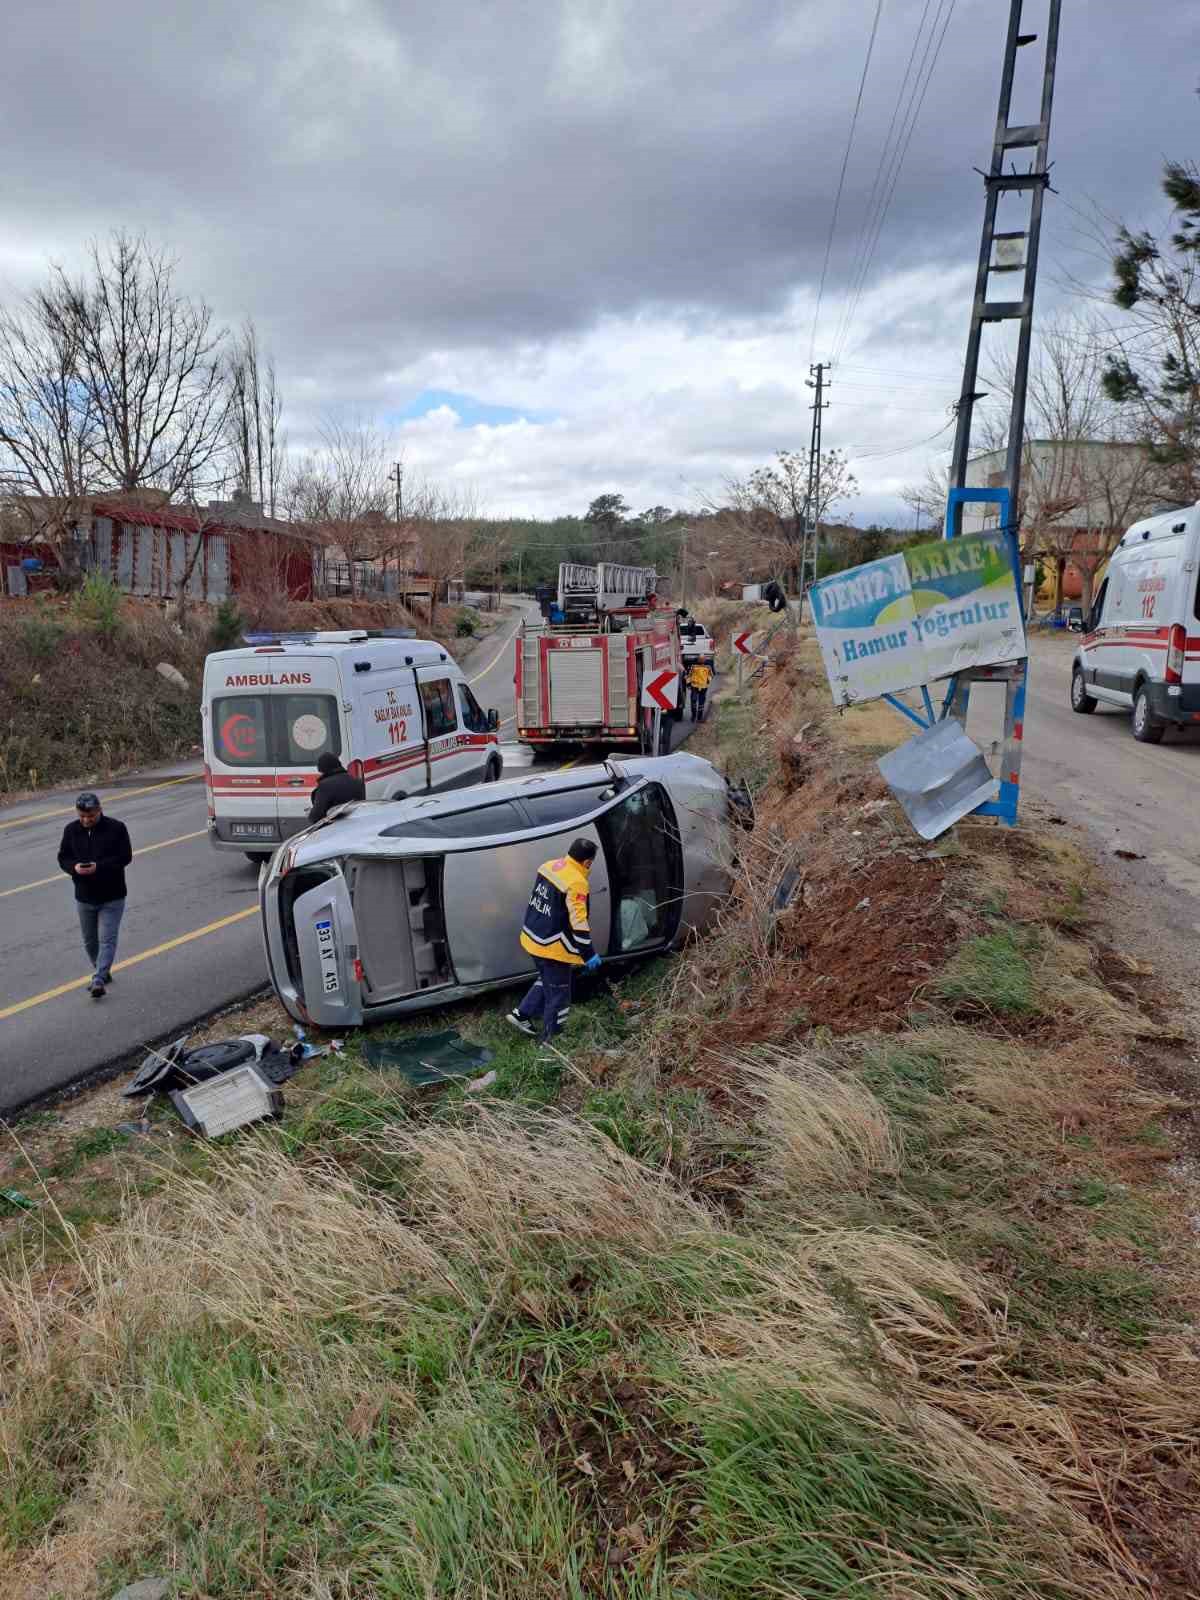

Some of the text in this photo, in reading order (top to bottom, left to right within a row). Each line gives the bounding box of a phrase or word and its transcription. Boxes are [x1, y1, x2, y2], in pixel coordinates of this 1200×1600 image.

[1142, 595, 1155, 618] 112
[842, 629, 907, 662] Hamur
[225, 672, 312, 687] AMBULANS
[388, 720, 407, 745] 112
[319, 928, 338, 991] 33 AY 415
